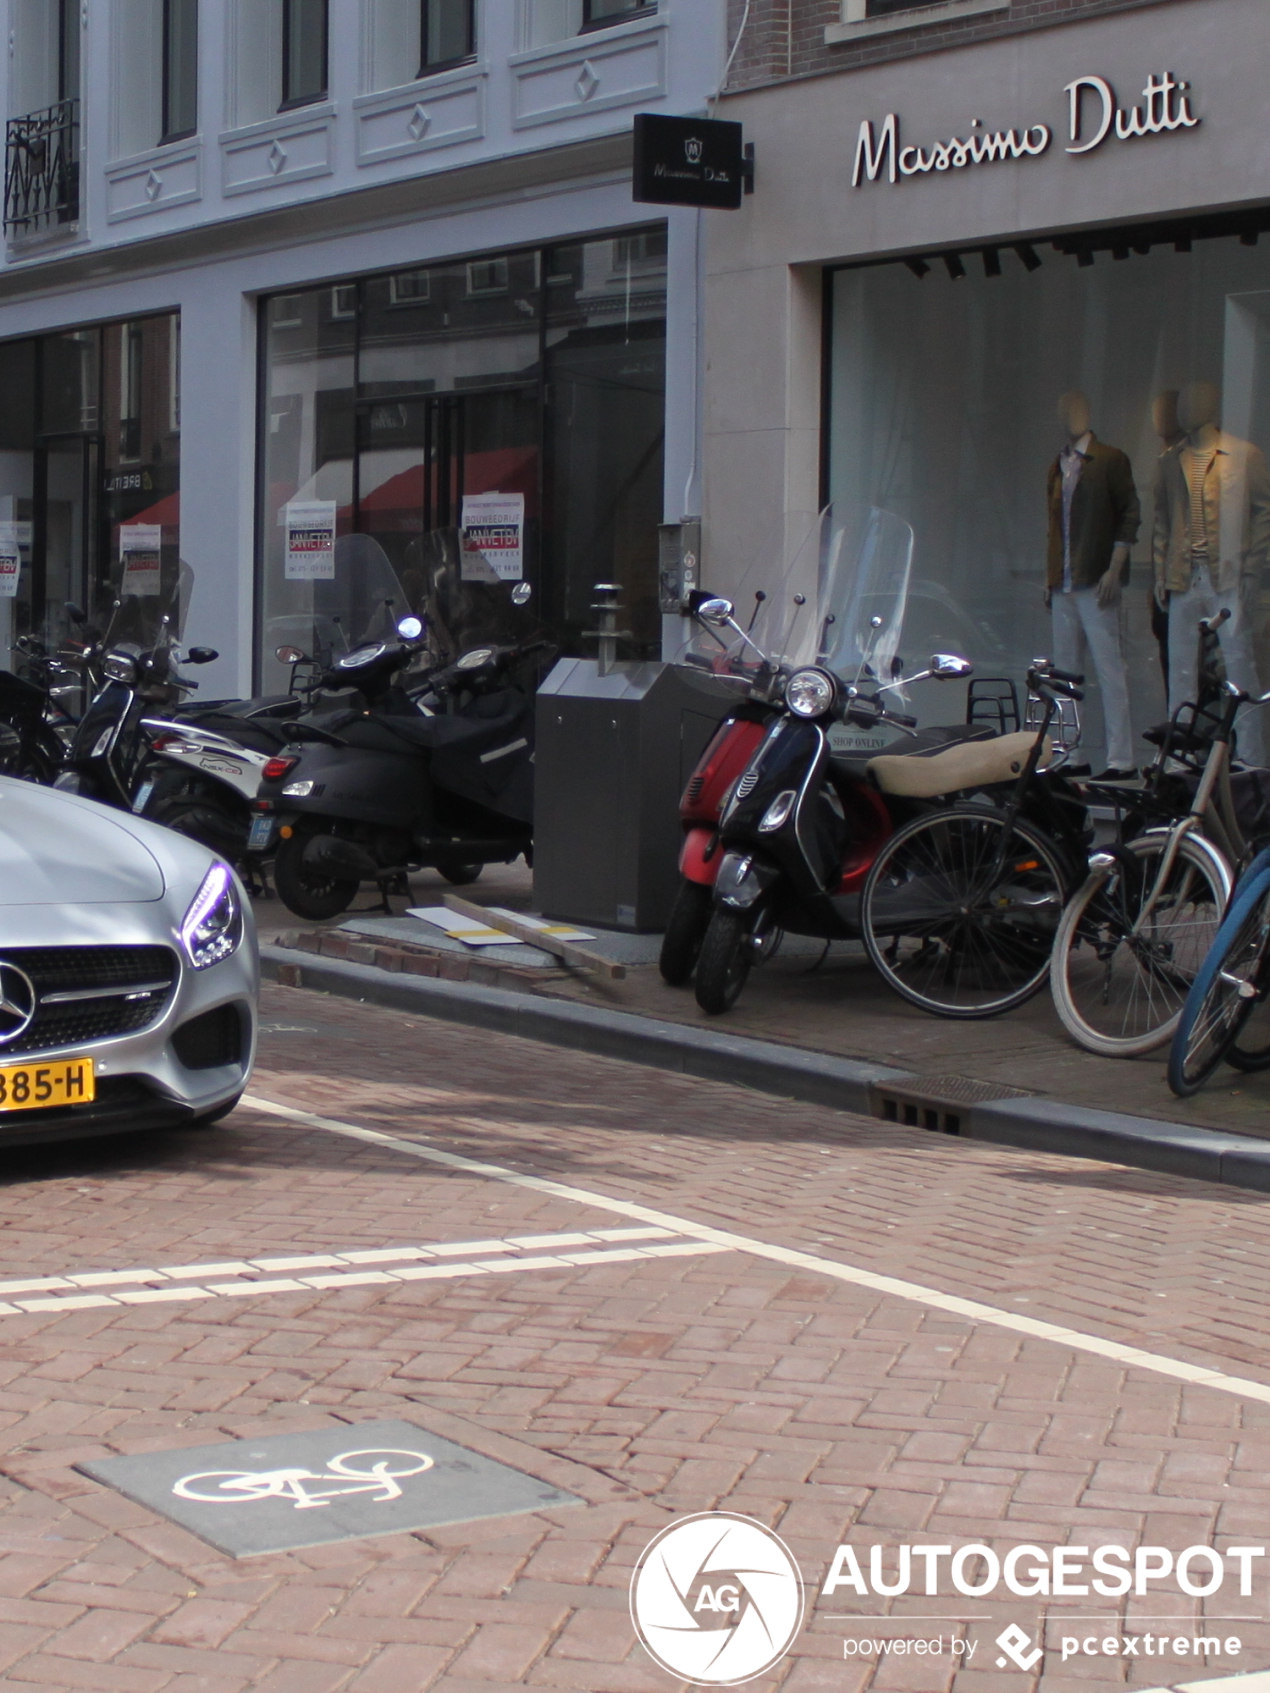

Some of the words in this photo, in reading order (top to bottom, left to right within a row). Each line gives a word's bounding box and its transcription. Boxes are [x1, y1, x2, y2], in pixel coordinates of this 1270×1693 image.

[851, 113, 1052, 187] Massimo
[1063, 71, 1202, 153] Dutti
[832, 737, 853, 747] SHOP
